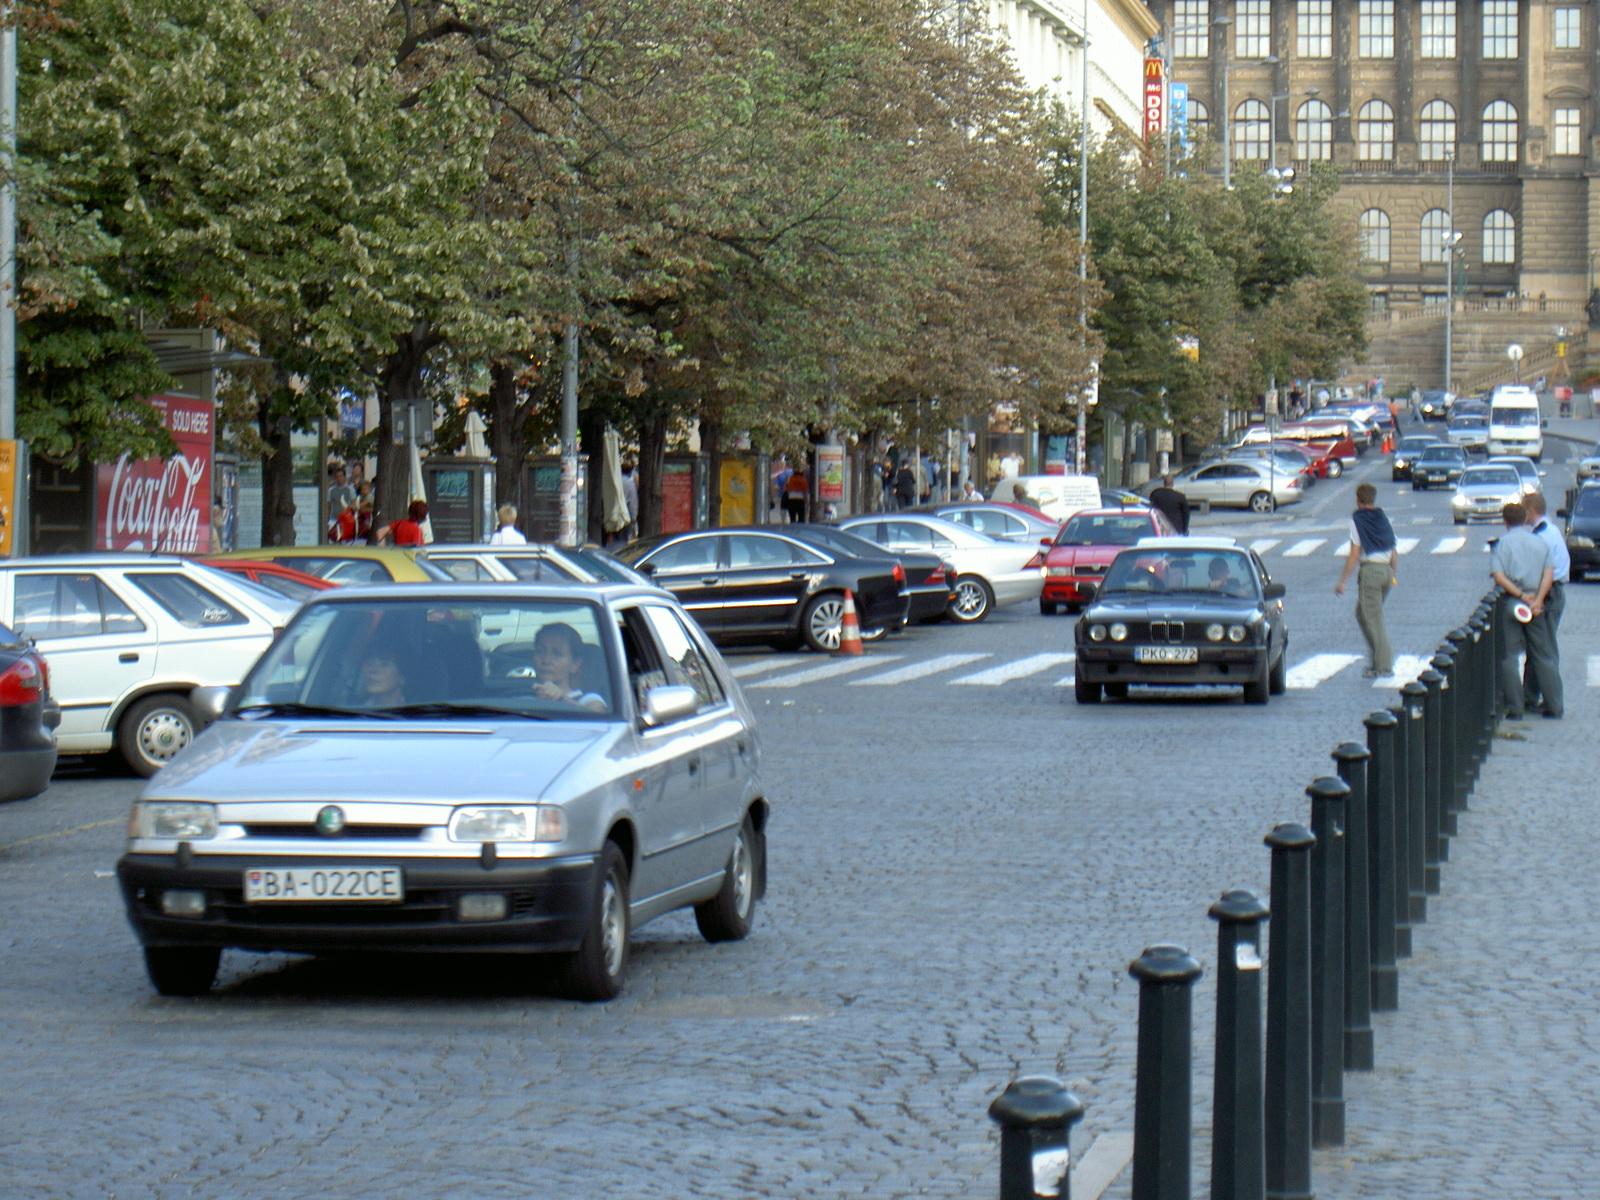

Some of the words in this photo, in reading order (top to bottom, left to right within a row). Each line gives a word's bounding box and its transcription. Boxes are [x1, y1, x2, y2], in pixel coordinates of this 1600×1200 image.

[172, 409, 190, 432] SOLD
[191, 411, 209, 434] HERE
[264, 870, 397, 896] BA-022CE
